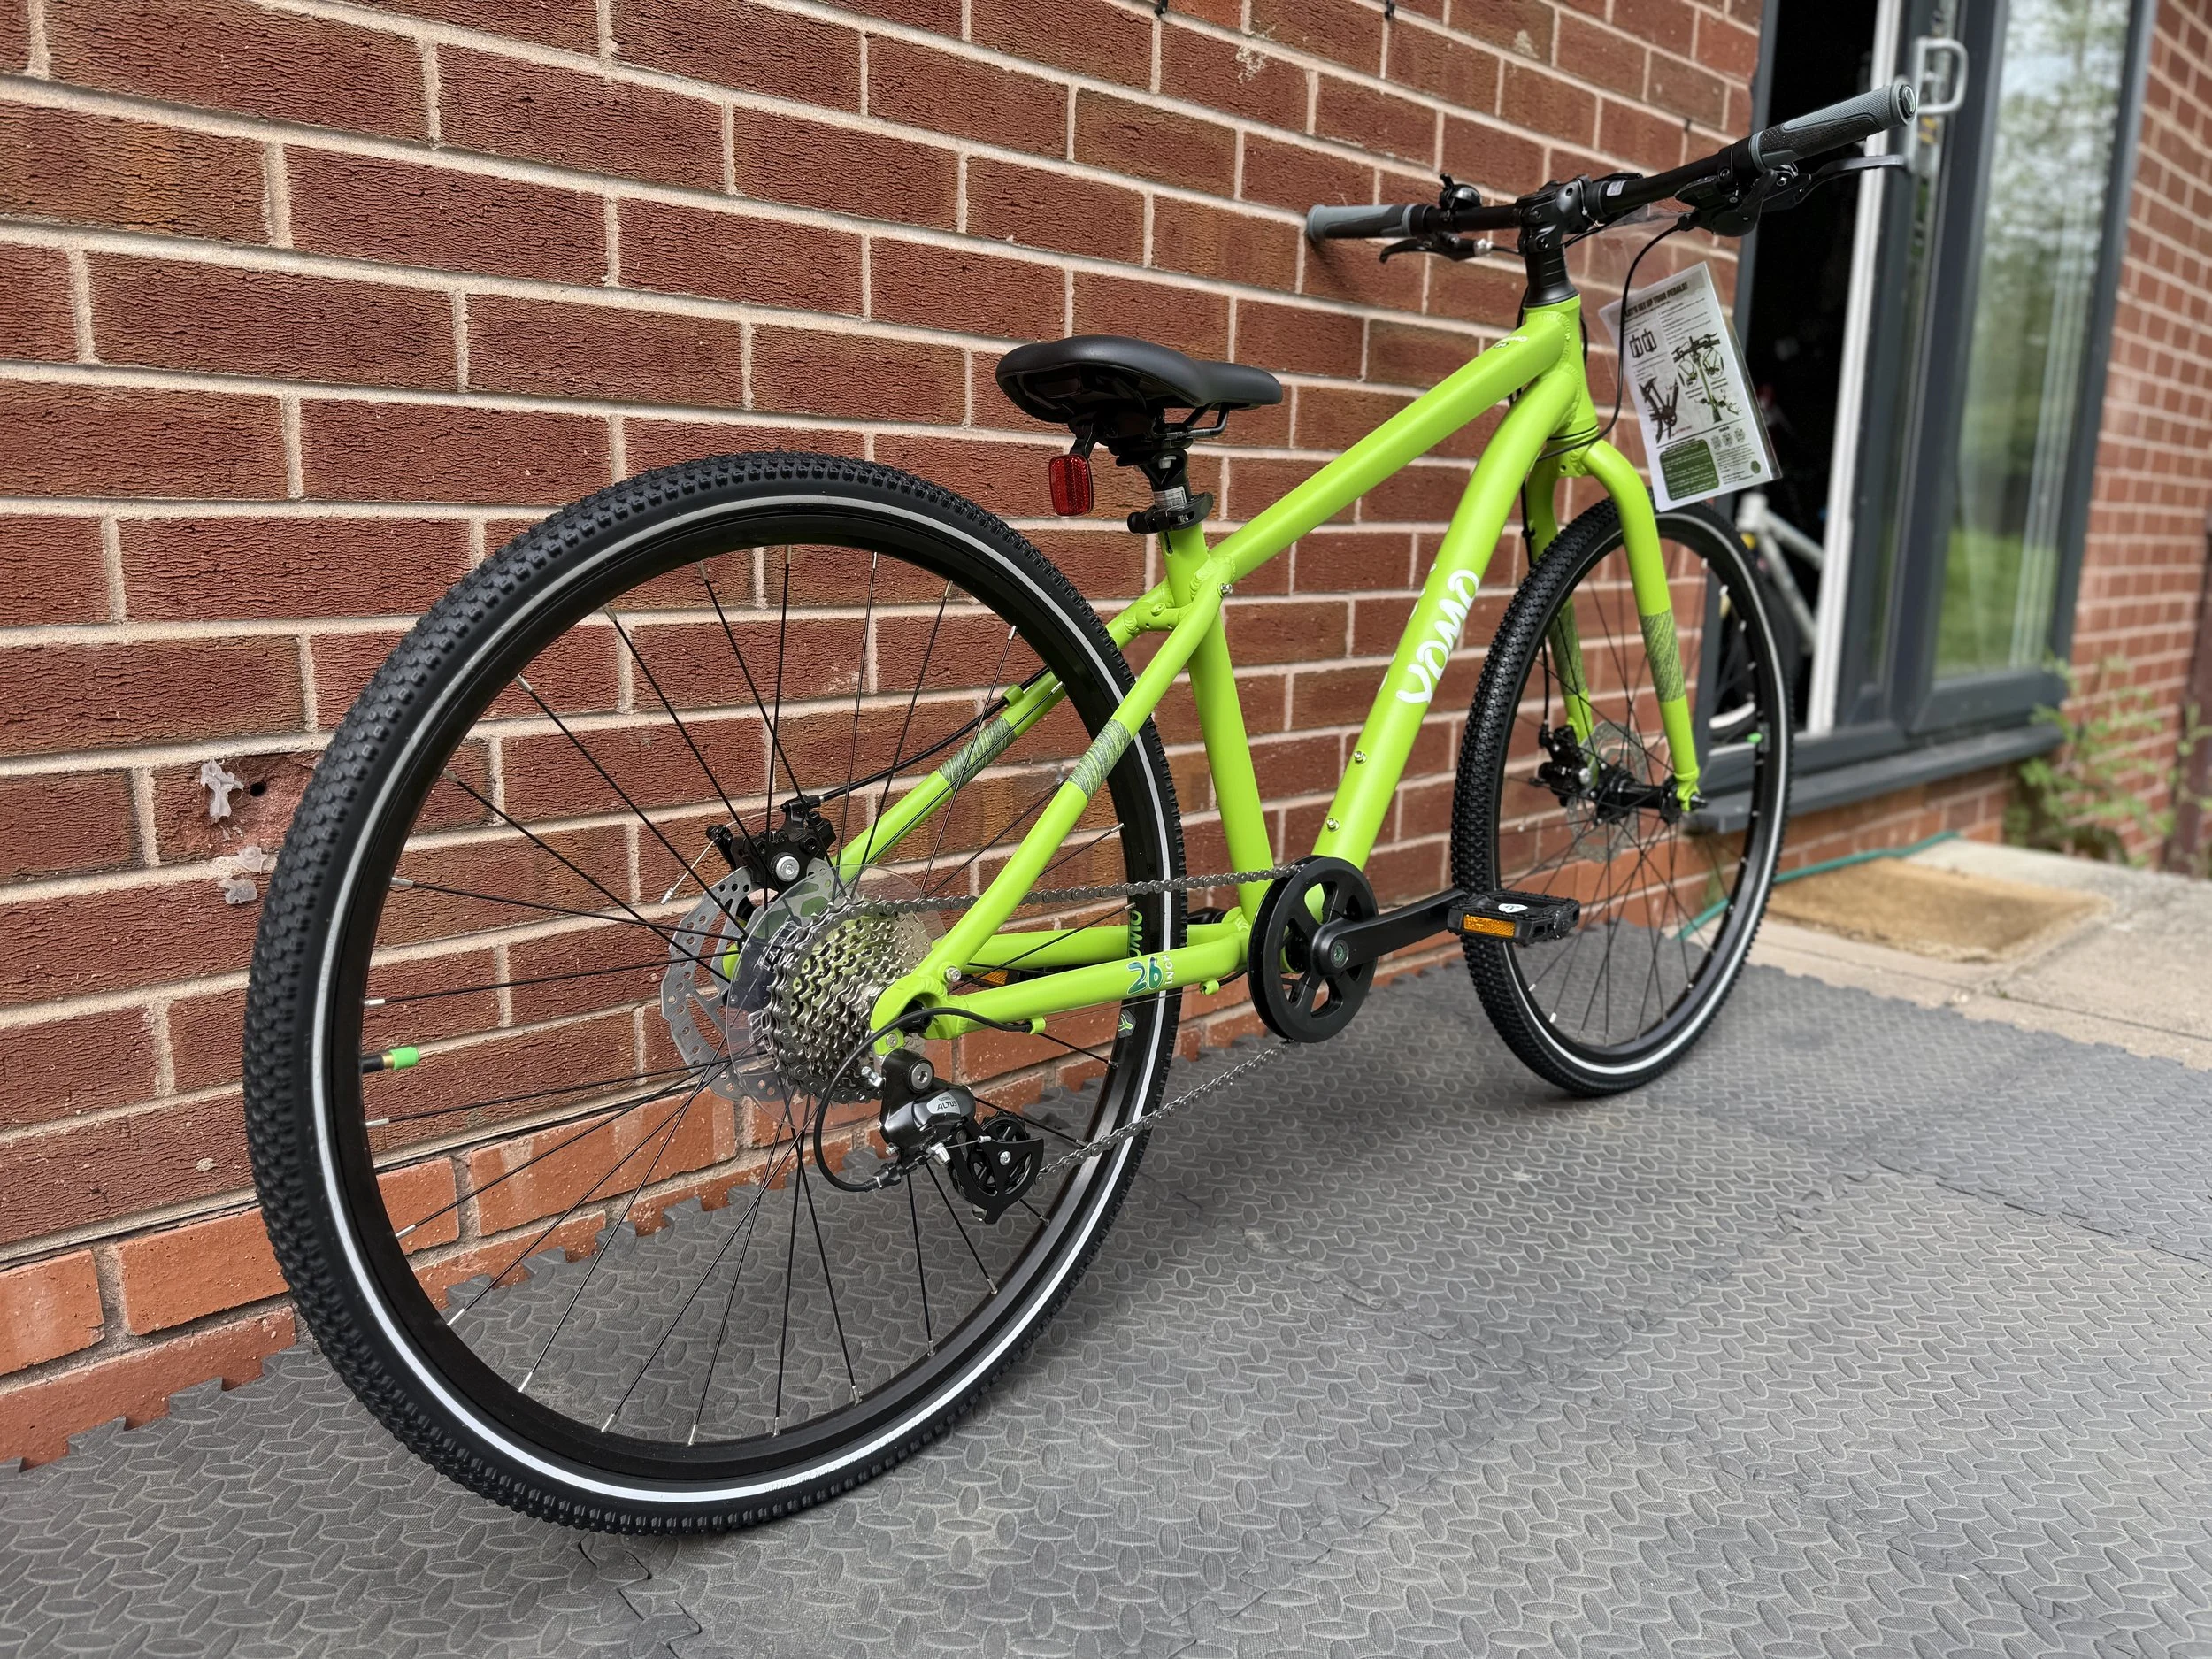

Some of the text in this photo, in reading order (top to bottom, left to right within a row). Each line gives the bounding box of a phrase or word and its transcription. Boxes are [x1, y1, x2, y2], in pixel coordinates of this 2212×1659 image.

[1126, 956, 1163, 995] 26
[1161, 955, 1174, 985] INCH
[937, 1101, 957, 1111] ALTUS
